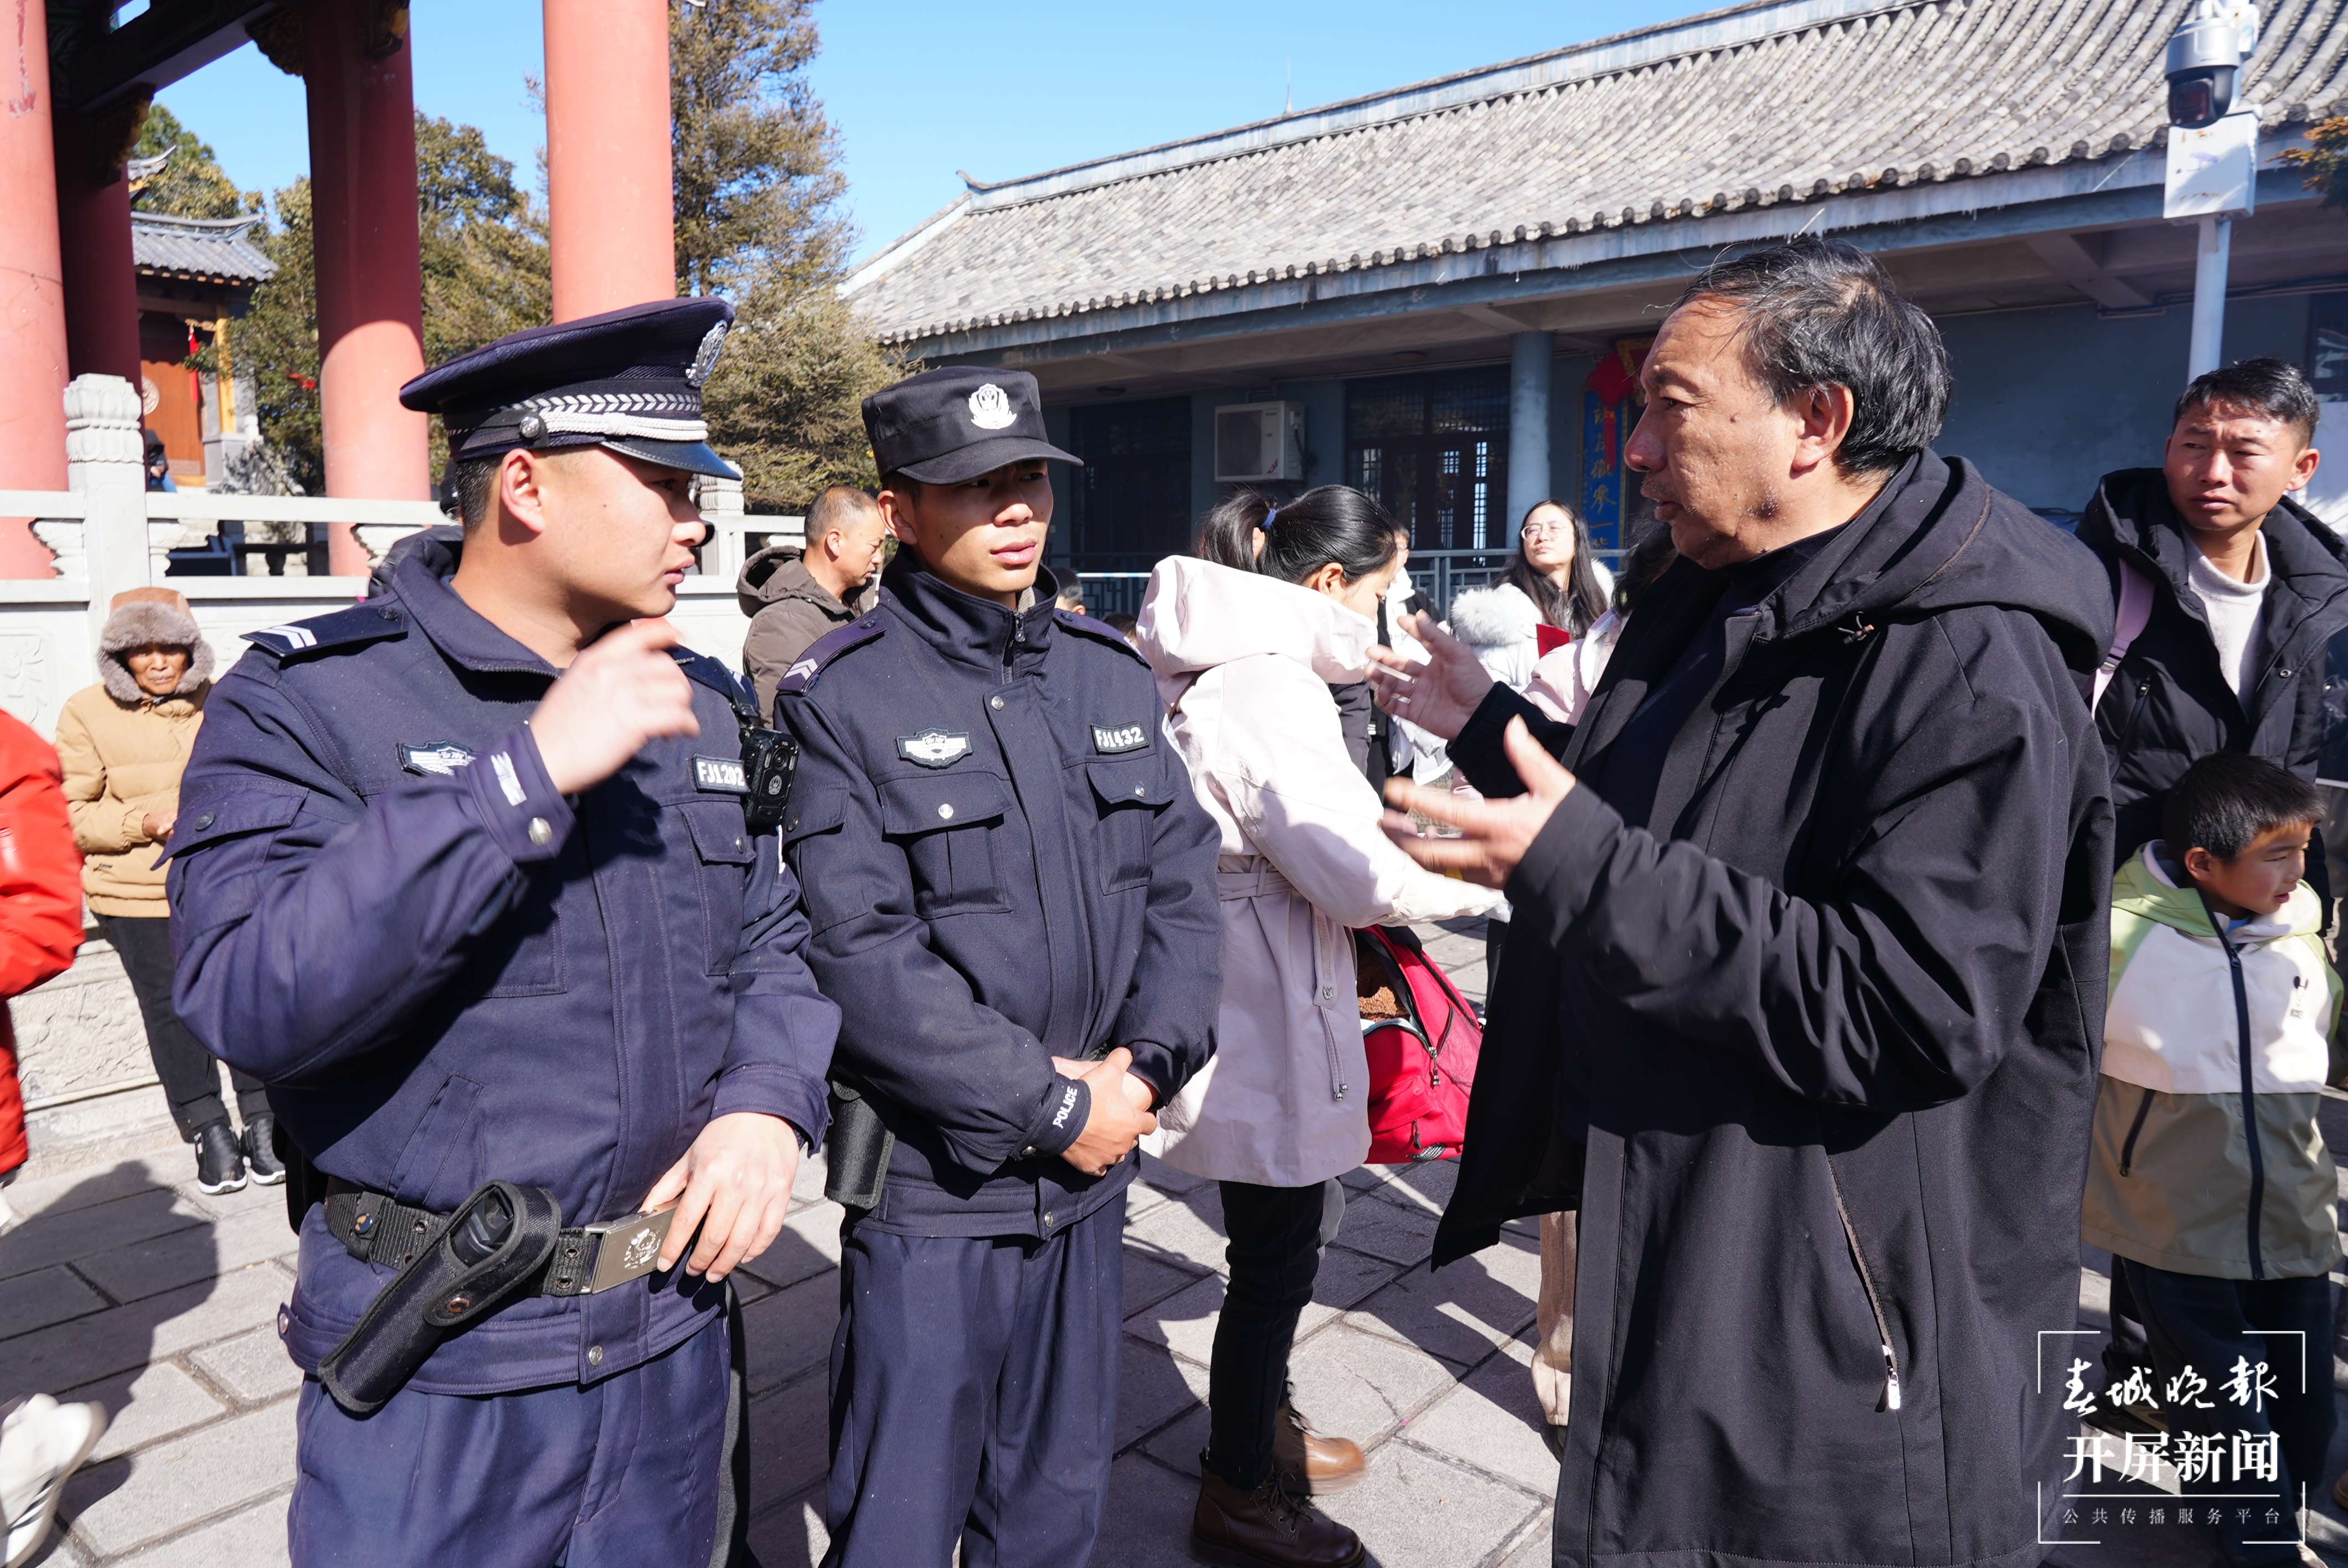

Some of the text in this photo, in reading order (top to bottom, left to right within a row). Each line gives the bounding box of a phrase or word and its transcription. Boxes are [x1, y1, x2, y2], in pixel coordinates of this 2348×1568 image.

[1095, 726, 1144, 747] FJ1432
[697, 761, 745, 786] FJ1202
[1052, 1086, 1078, 1129] POLICE
